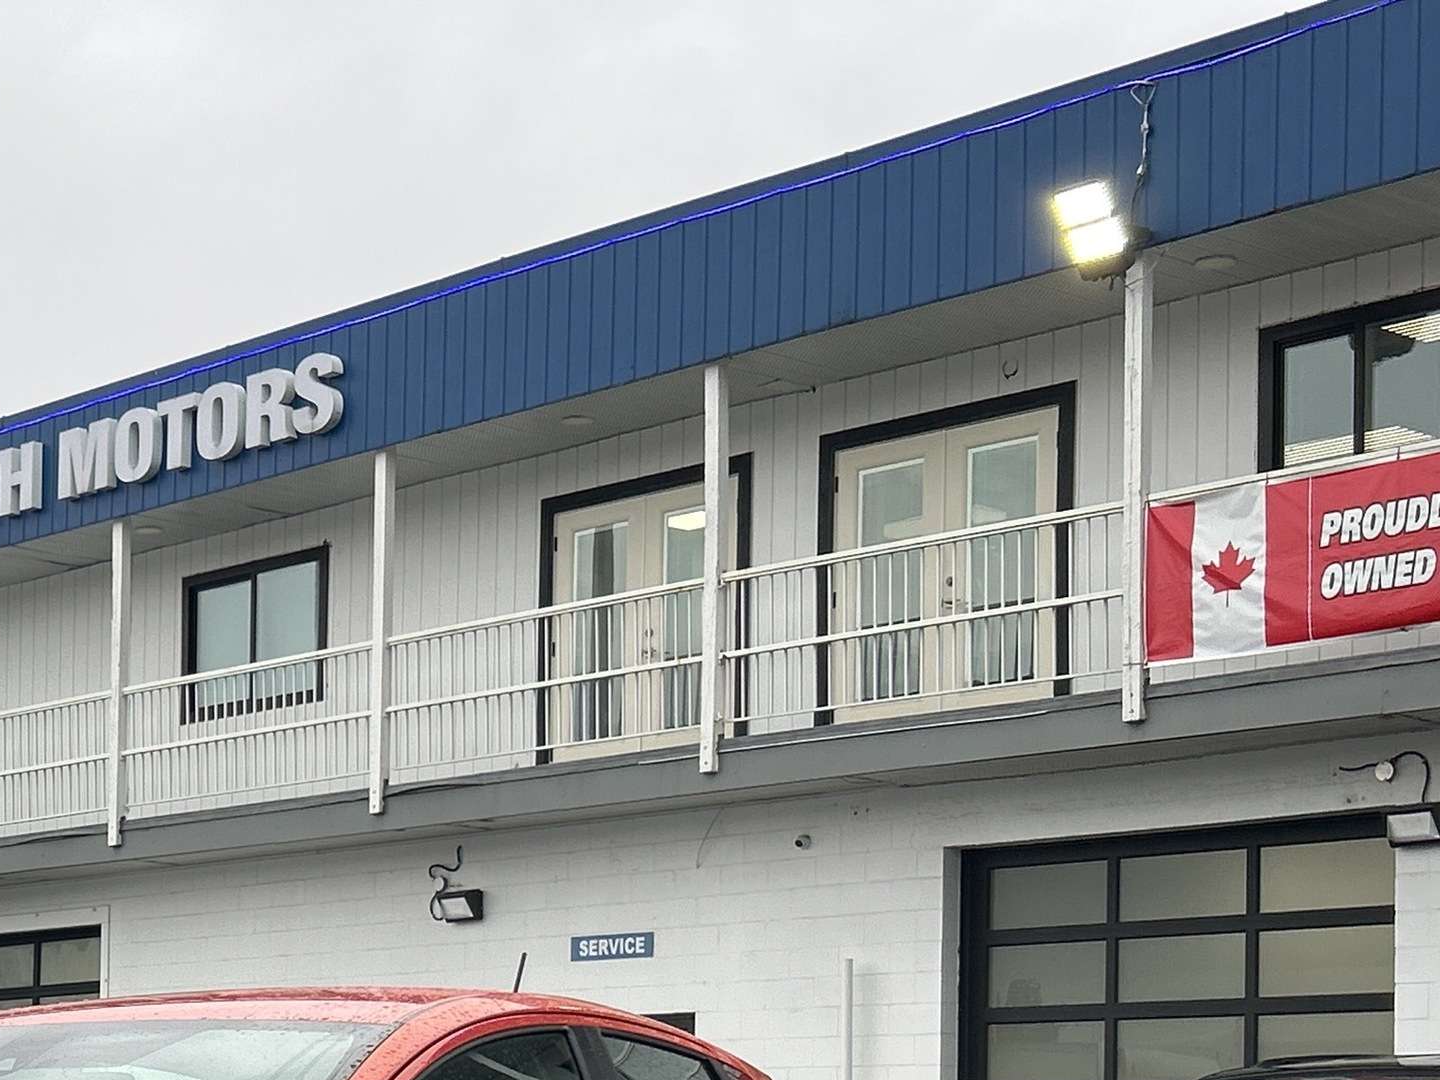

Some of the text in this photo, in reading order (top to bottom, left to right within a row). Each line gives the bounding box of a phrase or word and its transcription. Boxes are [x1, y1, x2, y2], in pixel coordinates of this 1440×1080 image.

[58, 352, 345, 500] MOTORS
[1320, 547, 1438, 600] OWNED
[579, 936, 645, 957] SERVICE
